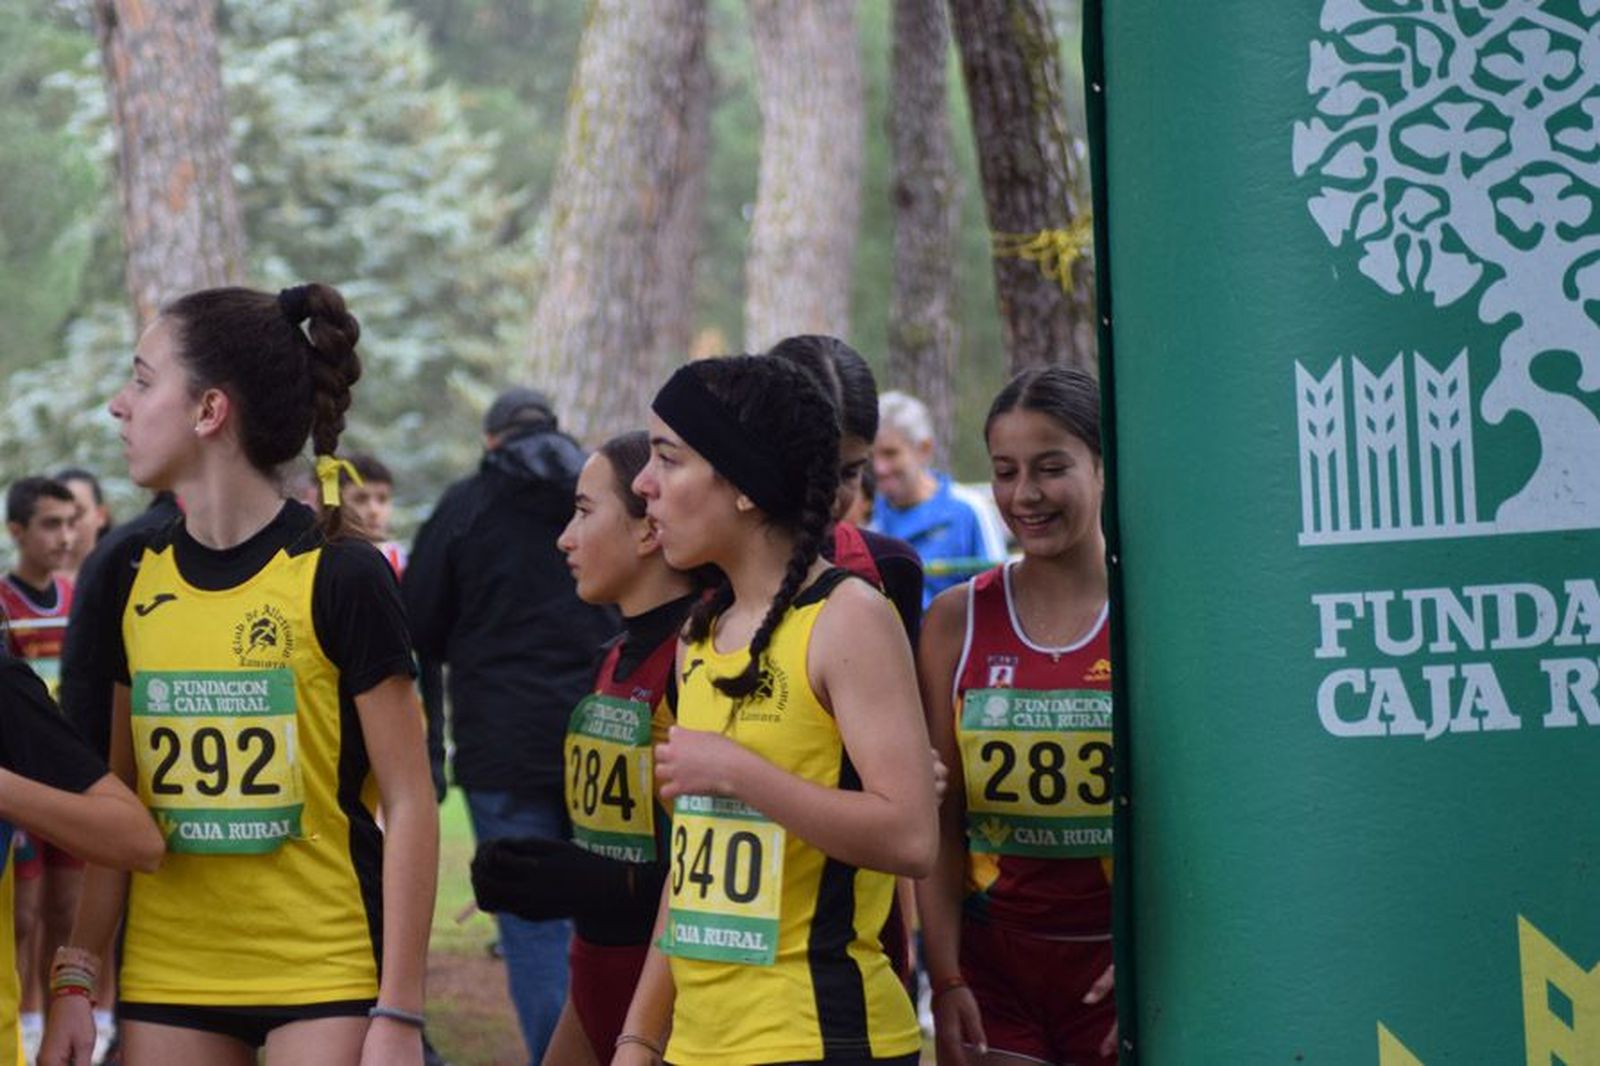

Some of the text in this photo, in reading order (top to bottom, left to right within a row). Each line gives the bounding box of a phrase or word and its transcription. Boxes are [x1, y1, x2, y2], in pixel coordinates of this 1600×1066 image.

[1311, 578, 1600, 658] FUNDA
[172, 679, 269, 697] FUNDACION
[1316, 656, 1600, 741] CAJA R
[174, 696, 271, 712] CAJA RURAL
[1014, 697, 1113, 713] FUNDACION
[1013, 712, 1053, 728] CAJA
[149, 726, 281, 797] 292
[980, 740, 1114, 806] 283
[570, 744, 637, 821] 284
[179, 821, 223, 840] CAJA
[1014, 828, 1059, 846] CAJA
[672, 825, 763, 904] 340
[702, 926, 769, 951] RURAL
